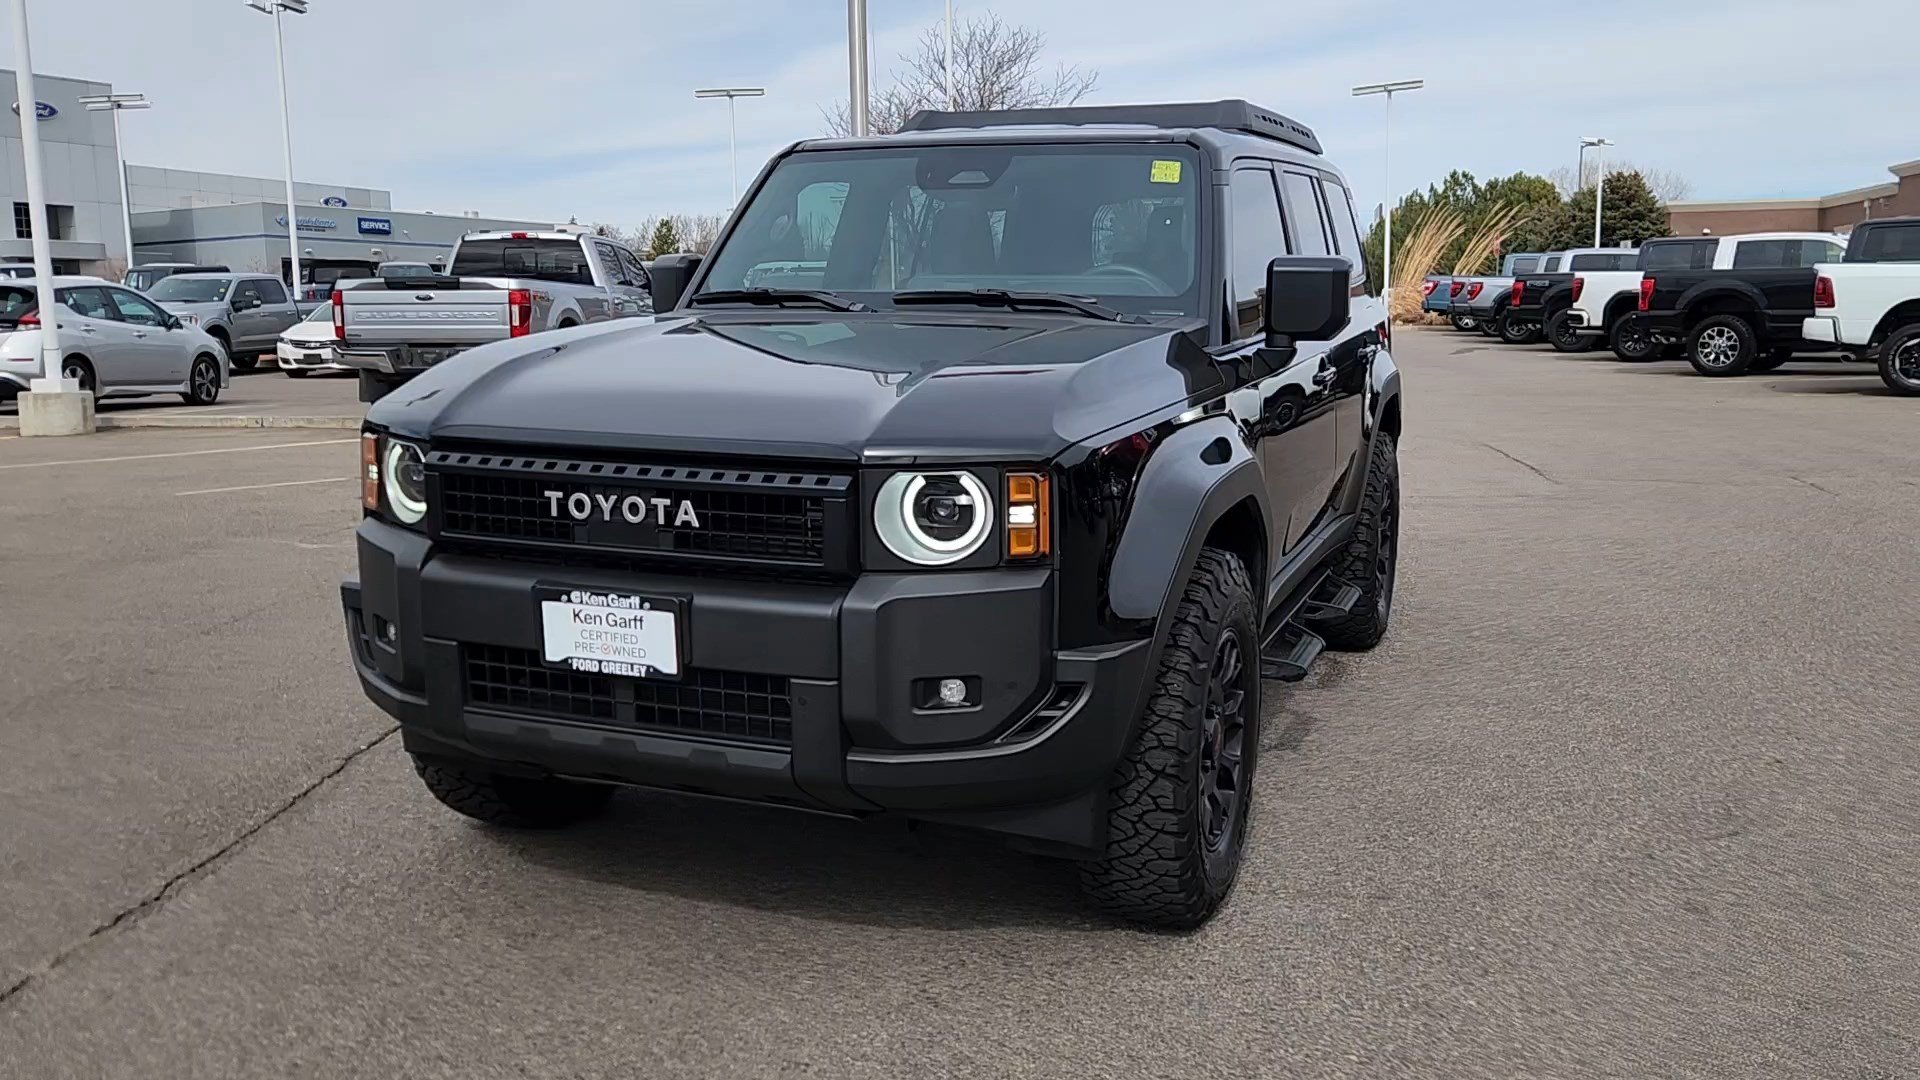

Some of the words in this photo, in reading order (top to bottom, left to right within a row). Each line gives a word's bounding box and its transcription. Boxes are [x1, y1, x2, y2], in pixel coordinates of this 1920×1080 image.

[361, 220, 390, 230] SERVICE
[356, 311, 435, 319] SUPER
[437, 311, 497, 319] DUTY
[544, 490, 700, 528] TOYOTA
[581, 592, 607, 607] Ken
[607, 593, 640, 609] Garff
[572, 608, 602, 625] Ken
[605, 612, 644, 630] Garff
[580, 629, 638, 645] CERTIFIED
[574, 641, 646, 659] PRE-OWNED
[571, 658, 599, 672] FORD
[601, 660, 647, 677] GREELEY
